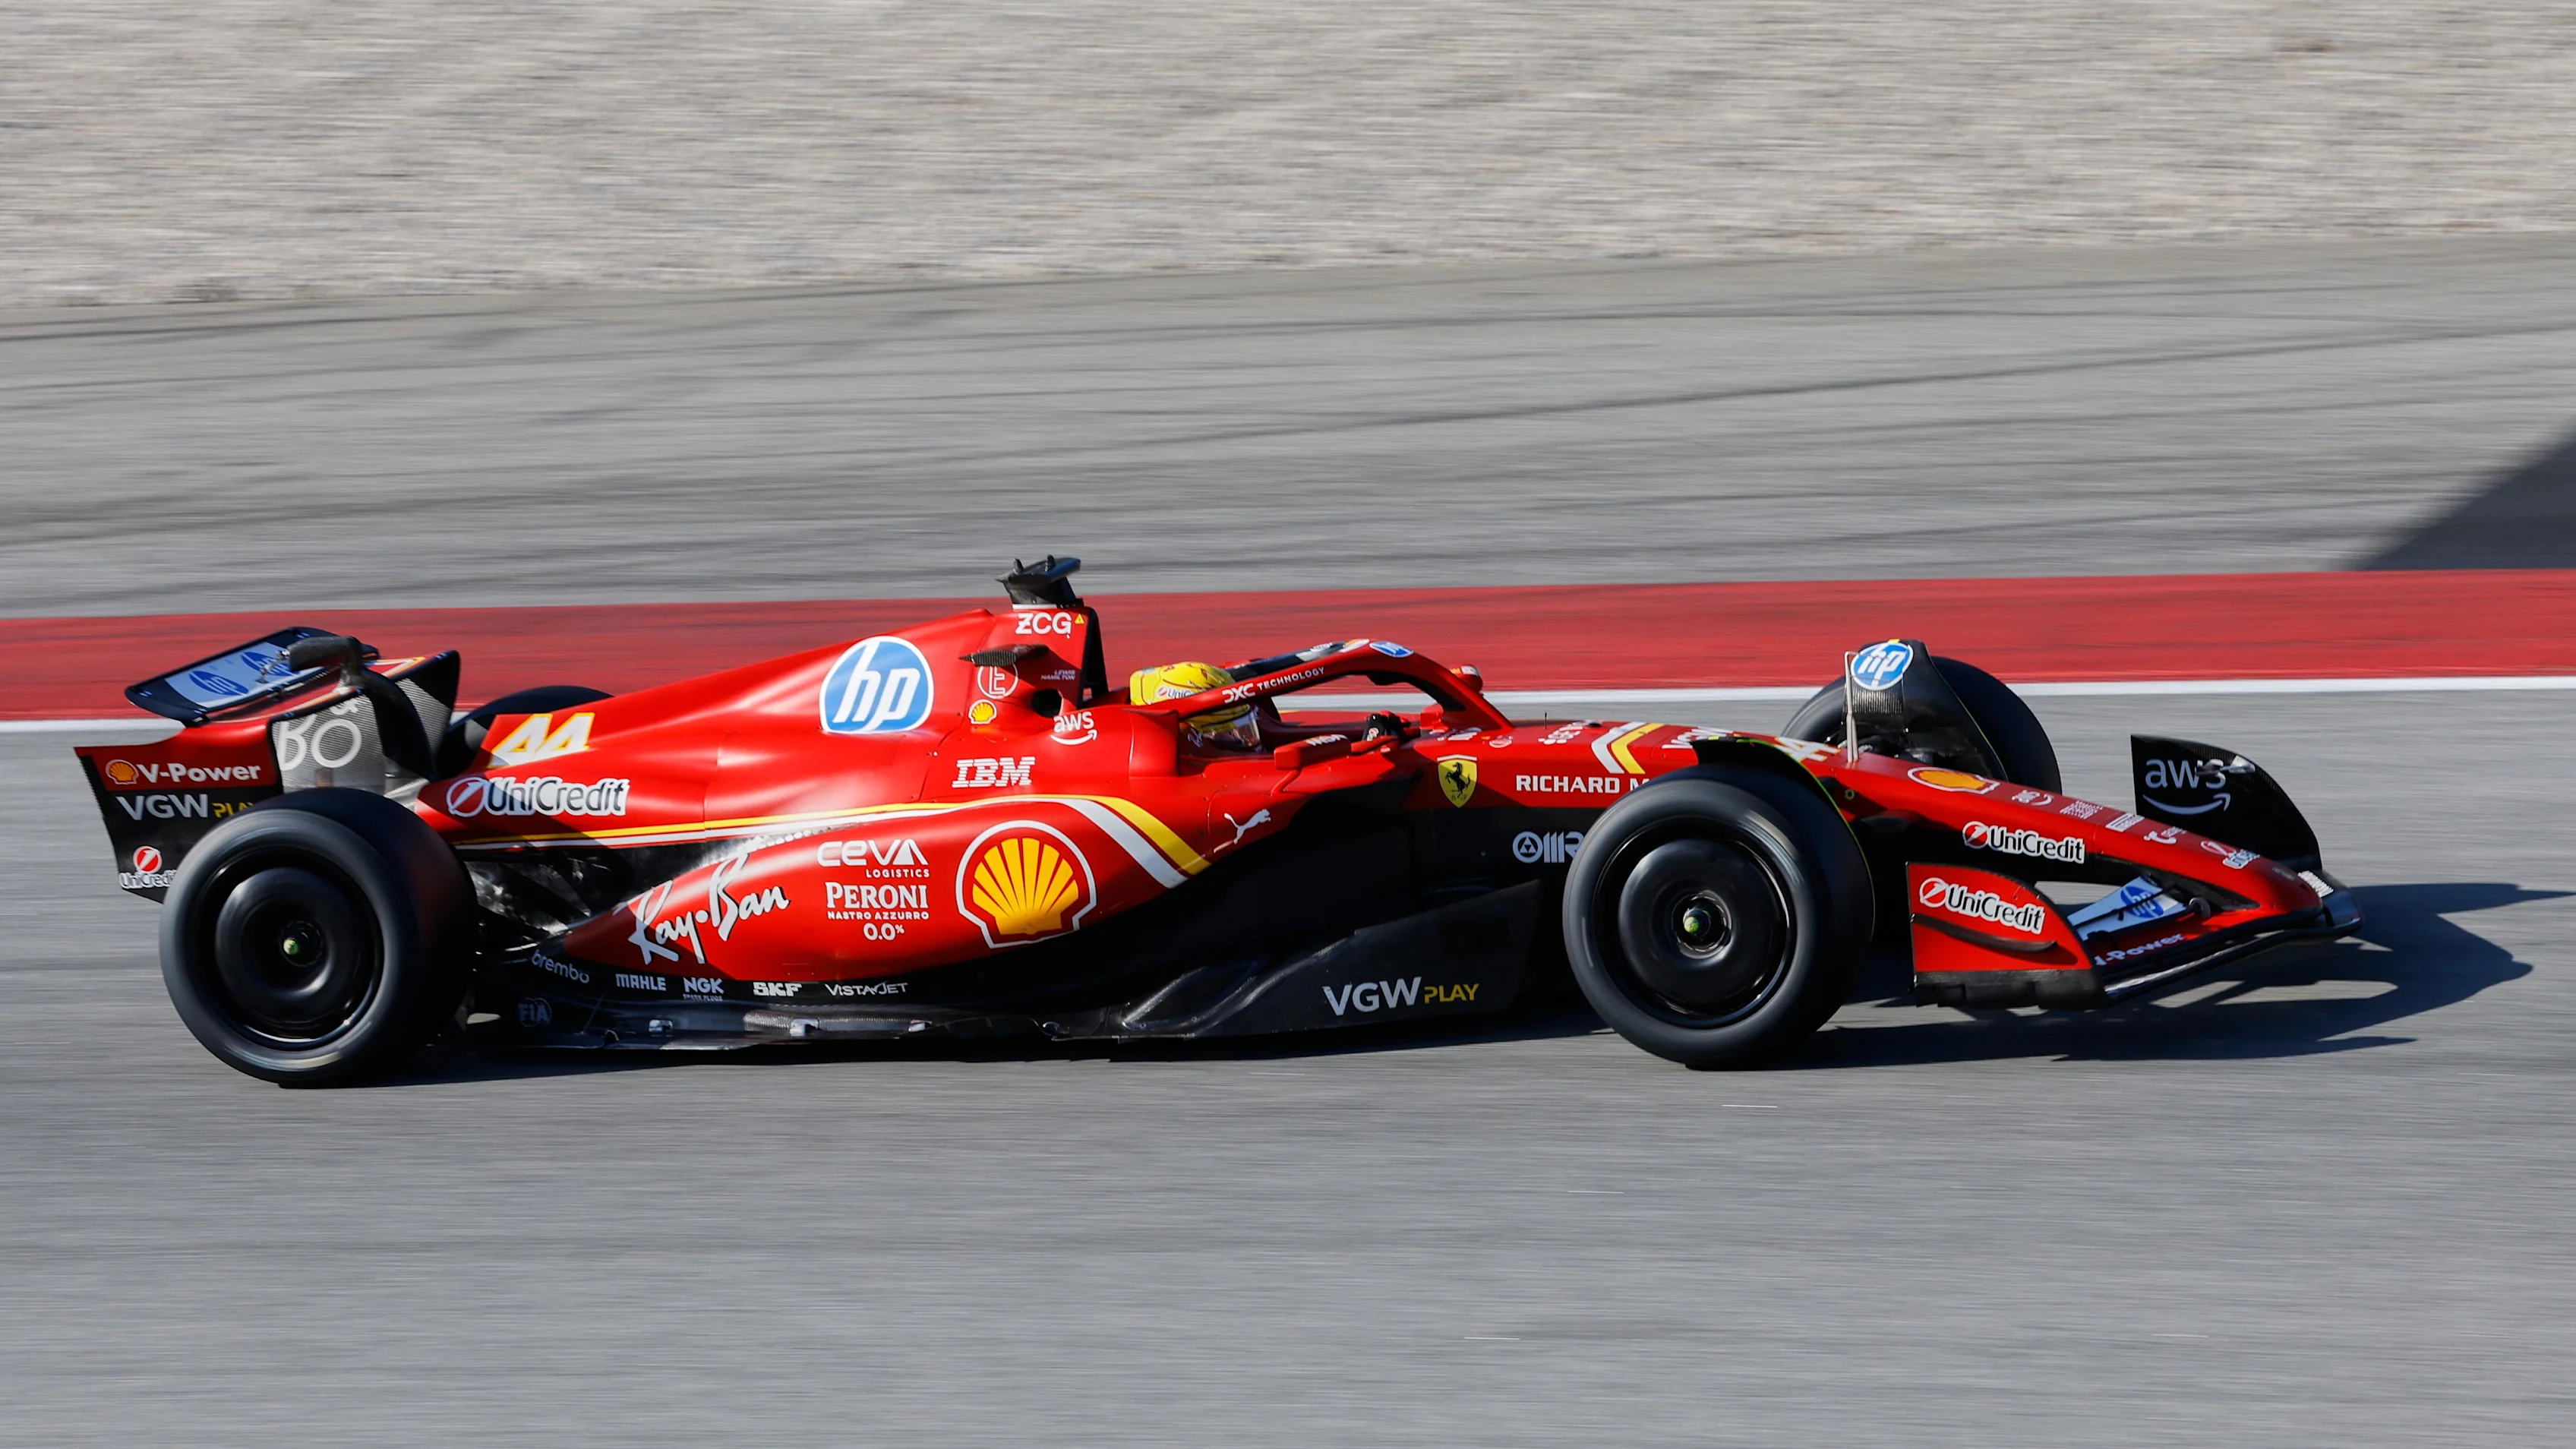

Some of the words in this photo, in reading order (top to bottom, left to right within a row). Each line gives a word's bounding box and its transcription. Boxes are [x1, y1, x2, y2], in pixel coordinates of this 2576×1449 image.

[1855, 644, 1908, 688] hp
[832, 639, 922, 733] hp
[1222, 683, 1256, 704] DXC
[1257, 667, 1324, 691] TECHNOLOGY
[1053, 712, 1094, 732] aws
[487, 712, 595, 770] 44
[137, 762, 261, 783] V-Power
[952, 756, 1036, 788] IBM
[1516, 775, 1620, 794] RICHARD
[2145, 759, 2227, 790] aws
[116, 794, 209, 820] VGW
[486, 777, 630, 816] UniCredit
[1989, 826, 2085, 863] UniCredit
[866, 869, 930, 879] LOGISTICS
[825, 882, 929, 910] PERONI
[1948, 883, 2046, 935] UniCredit
[828, 911, 871, 920] NASTRO
[875, 911, 929, 920] AZZURRO
[863, 923, 904, 940] 0.0%
[532, 949, 590, 984] brembo
[615, 973, 667, 991] MAHLE
[683, 977, 724, 994] NGK
[753, 982, 802, 997] SKF
[1322, 977, 1422, 1016] VGW
[1424, 983, 1479, 1004] PLAY
